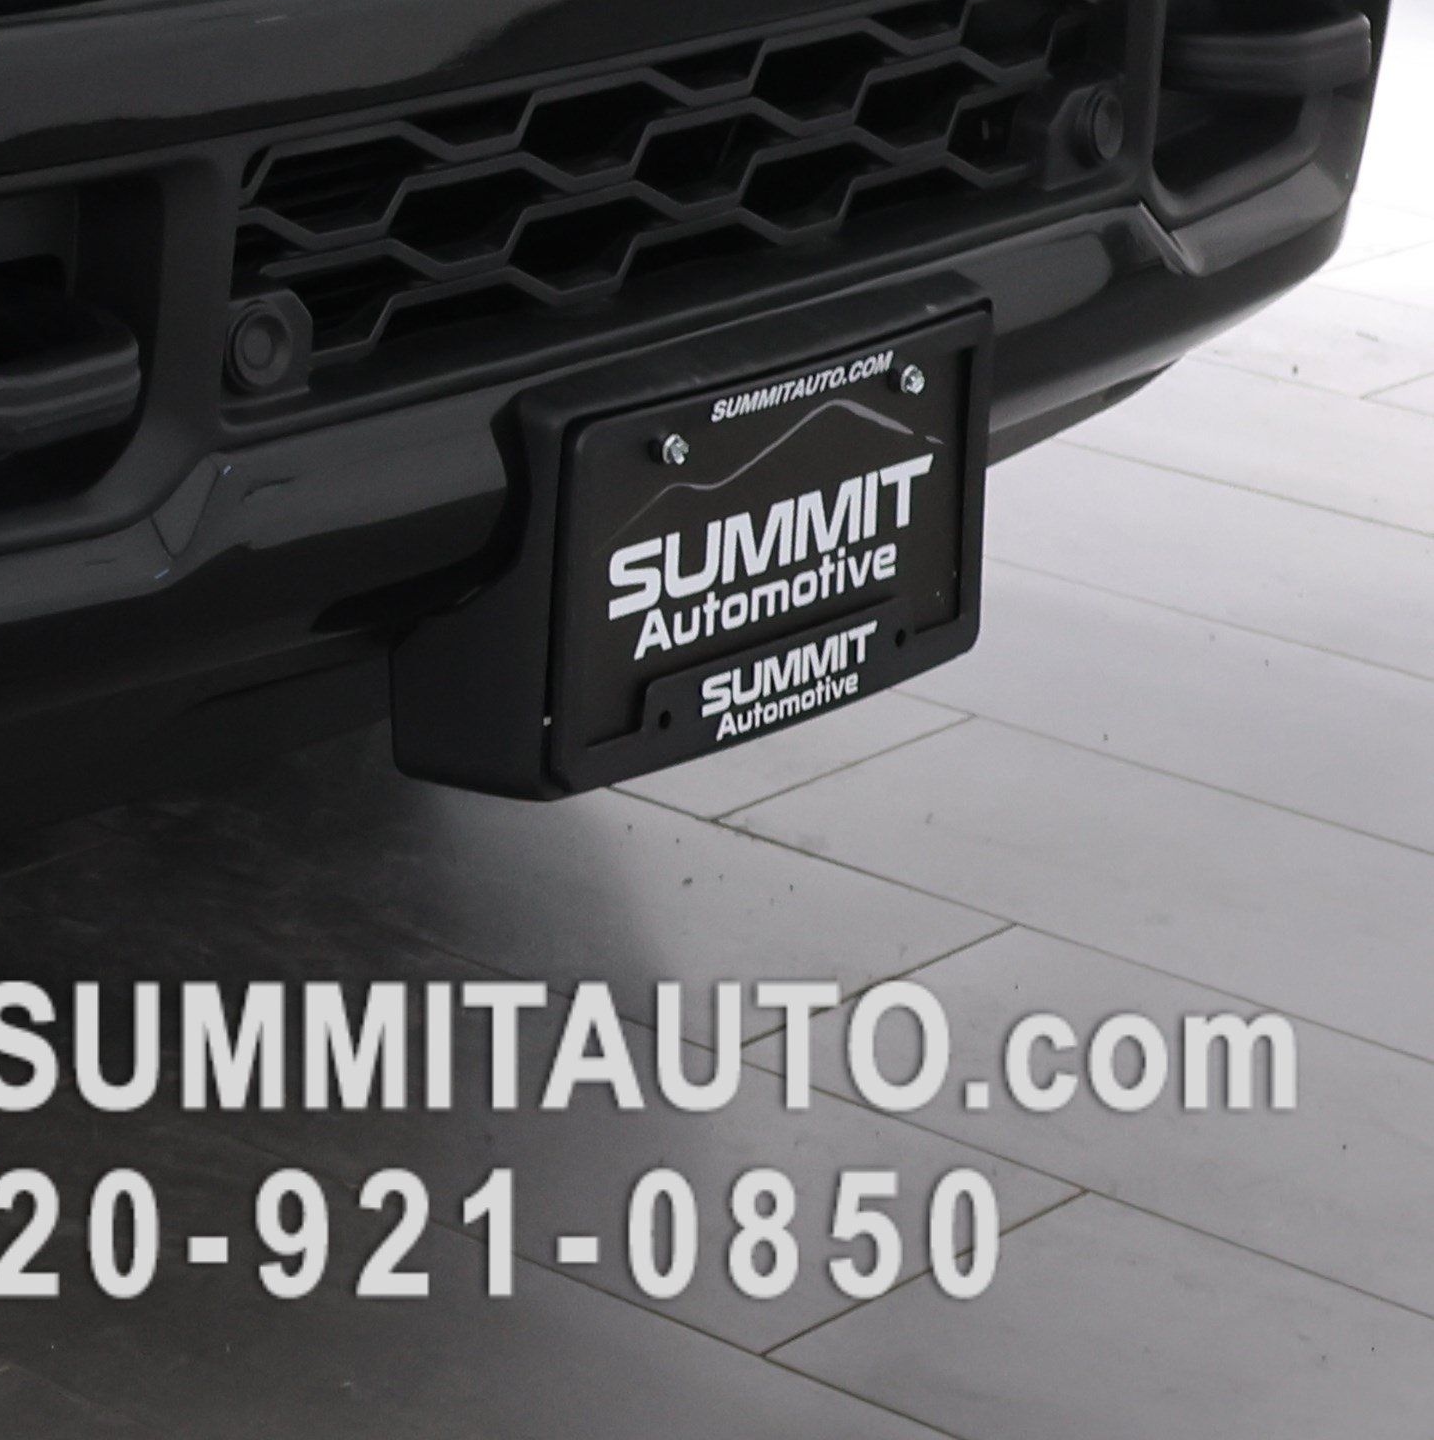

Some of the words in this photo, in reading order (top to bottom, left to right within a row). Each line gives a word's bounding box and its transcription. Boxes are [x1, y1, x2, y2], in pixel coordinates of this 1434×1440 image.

[710, 350, 894, 423] SUMMITAUTO.COM
[608, 453, 934, 621] SUMMIT
[633, 542, 898, 661] Automotive
[701, 620, 878, 718] SUMMIT
[715, 672, 859, 741] Automotive
